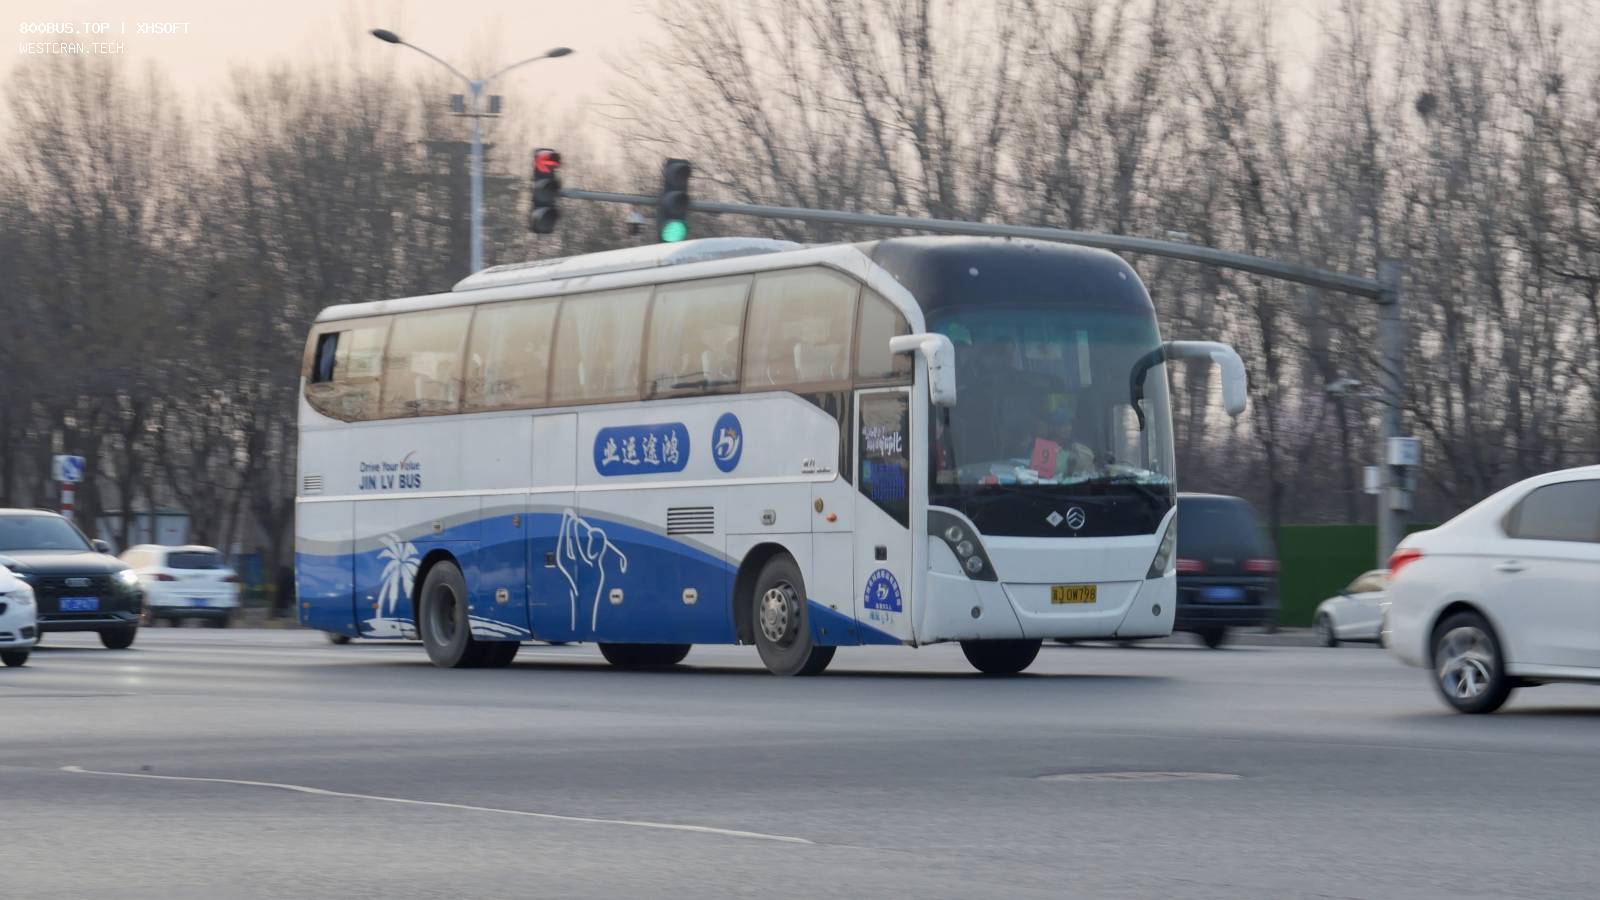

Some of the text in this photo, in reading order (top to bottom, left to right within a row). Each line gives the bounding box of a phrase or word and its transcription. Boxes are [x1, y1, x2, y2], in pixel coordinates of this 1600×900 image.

[360, 462, 380, 472] Drive
[382, 461, 398, 471] Your
[359, 473, 421, 489] JIN LV BUS
